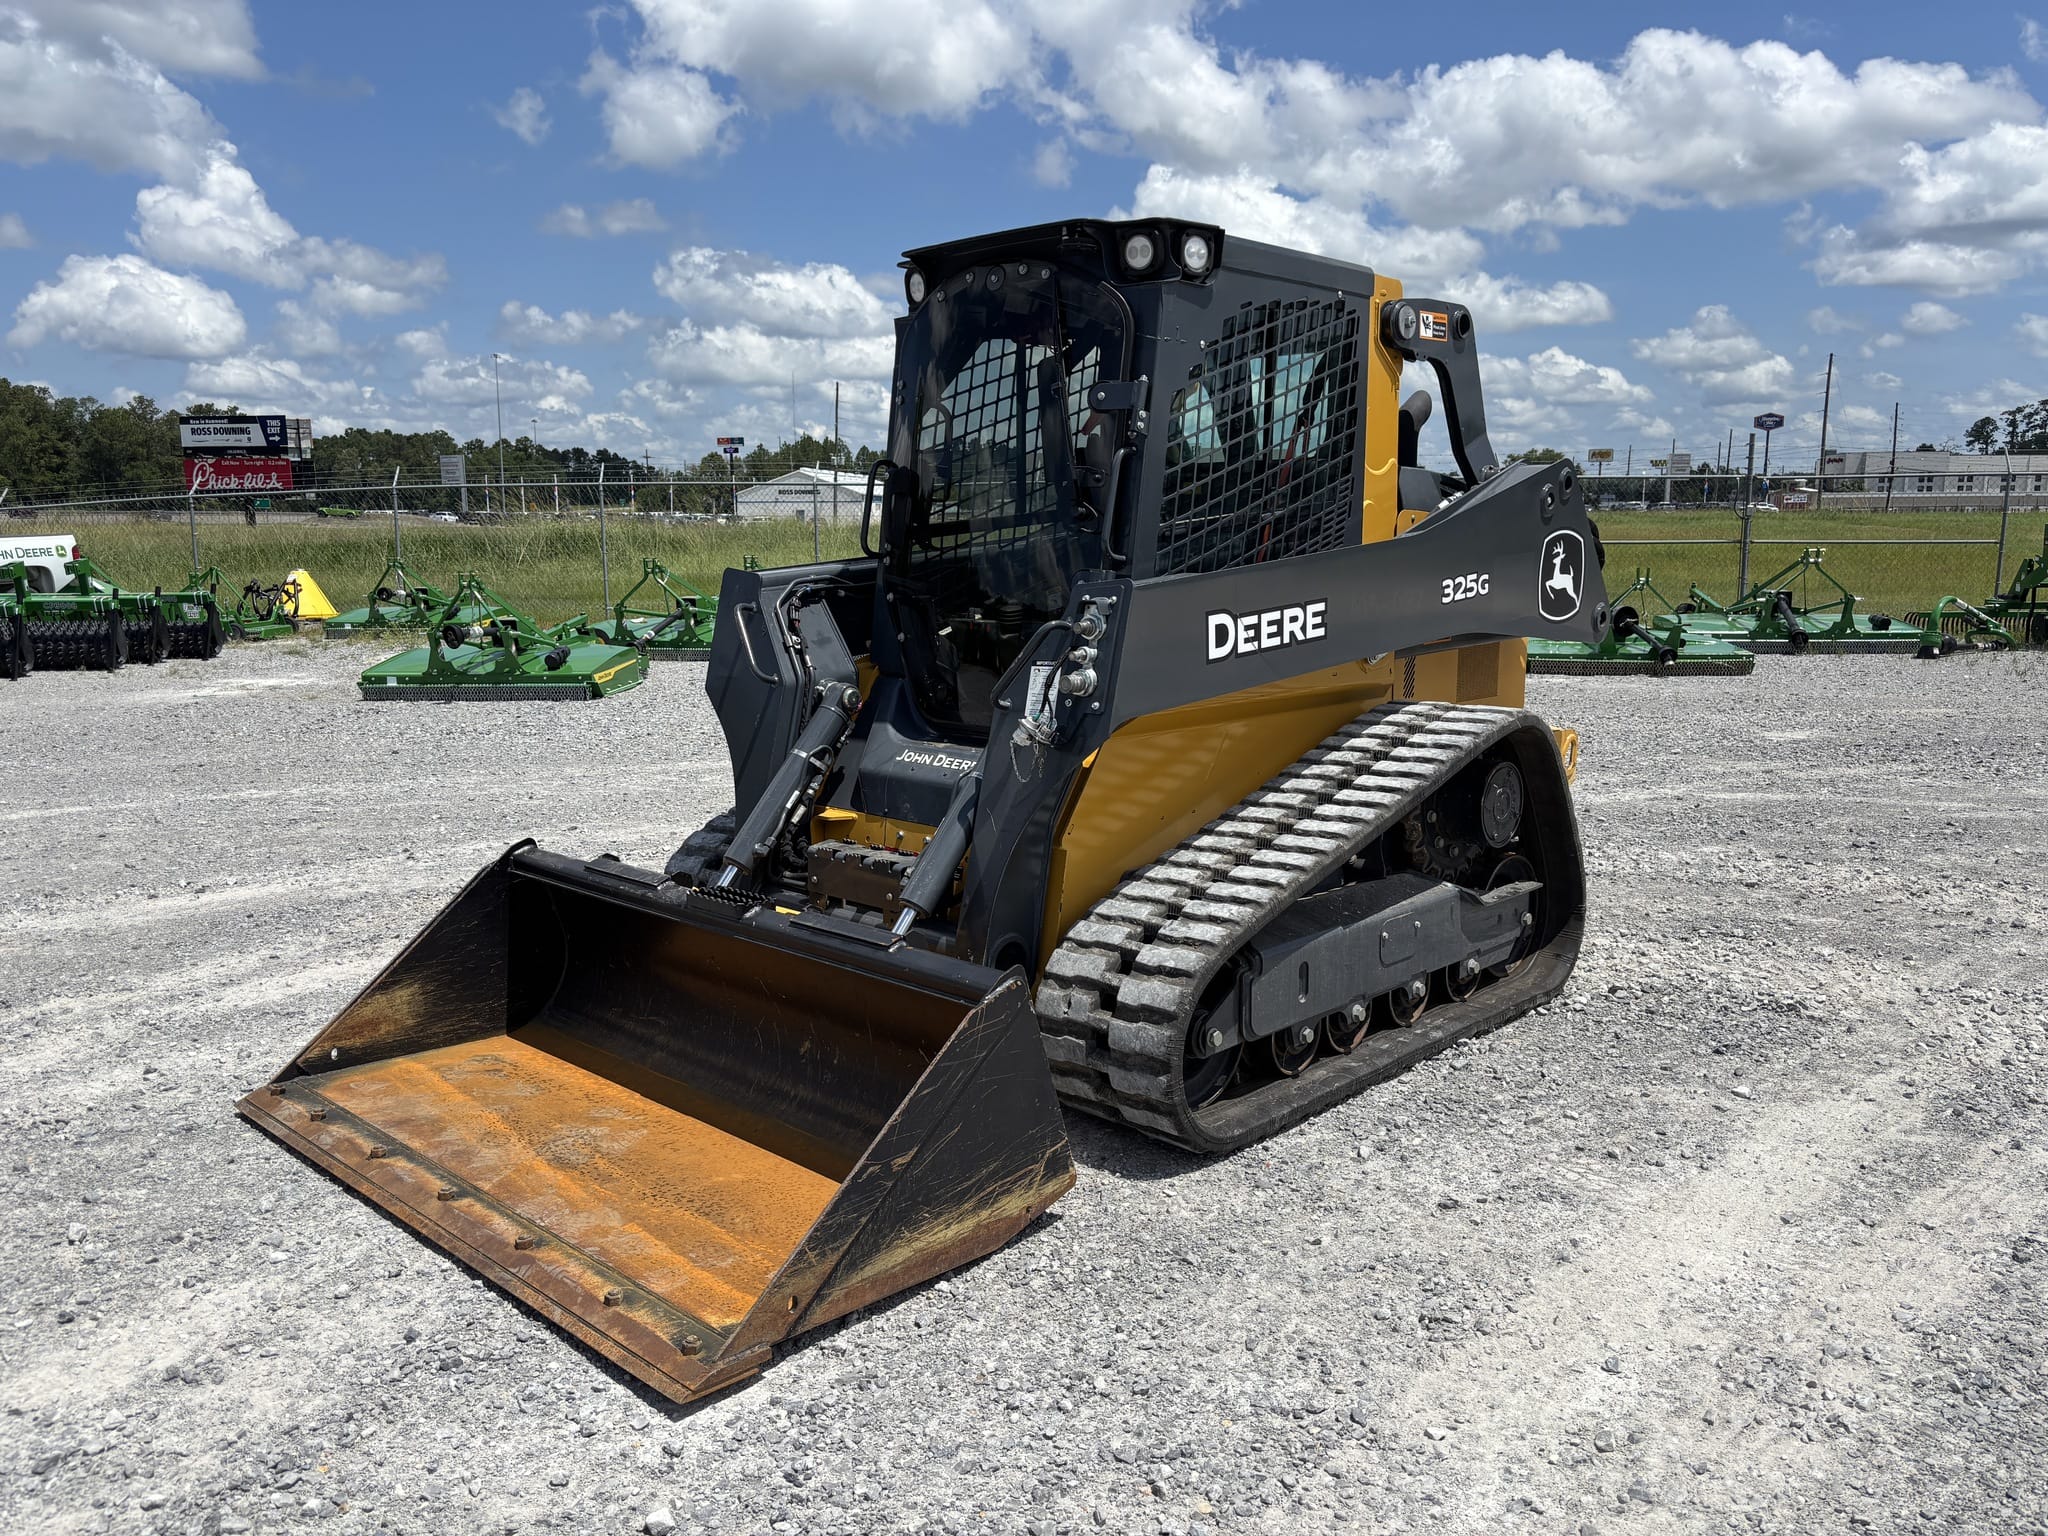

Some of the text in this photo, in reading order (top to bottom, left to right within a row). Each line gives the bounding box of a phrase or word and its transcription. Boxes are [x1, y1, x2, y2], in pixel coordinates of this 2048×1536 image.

[191, 426, 251, 436] ROSS DOWNING
[266, 419, 281, 427] THIS
[193, 461, 284, 489] Chick-fil-A
[15, 547, 55, 559] DEERE
[1441, 573, 1489, 604] 325G
[1208, 601, 1327, 661] DEERE
[896, 748, 933, 765] JOHN
